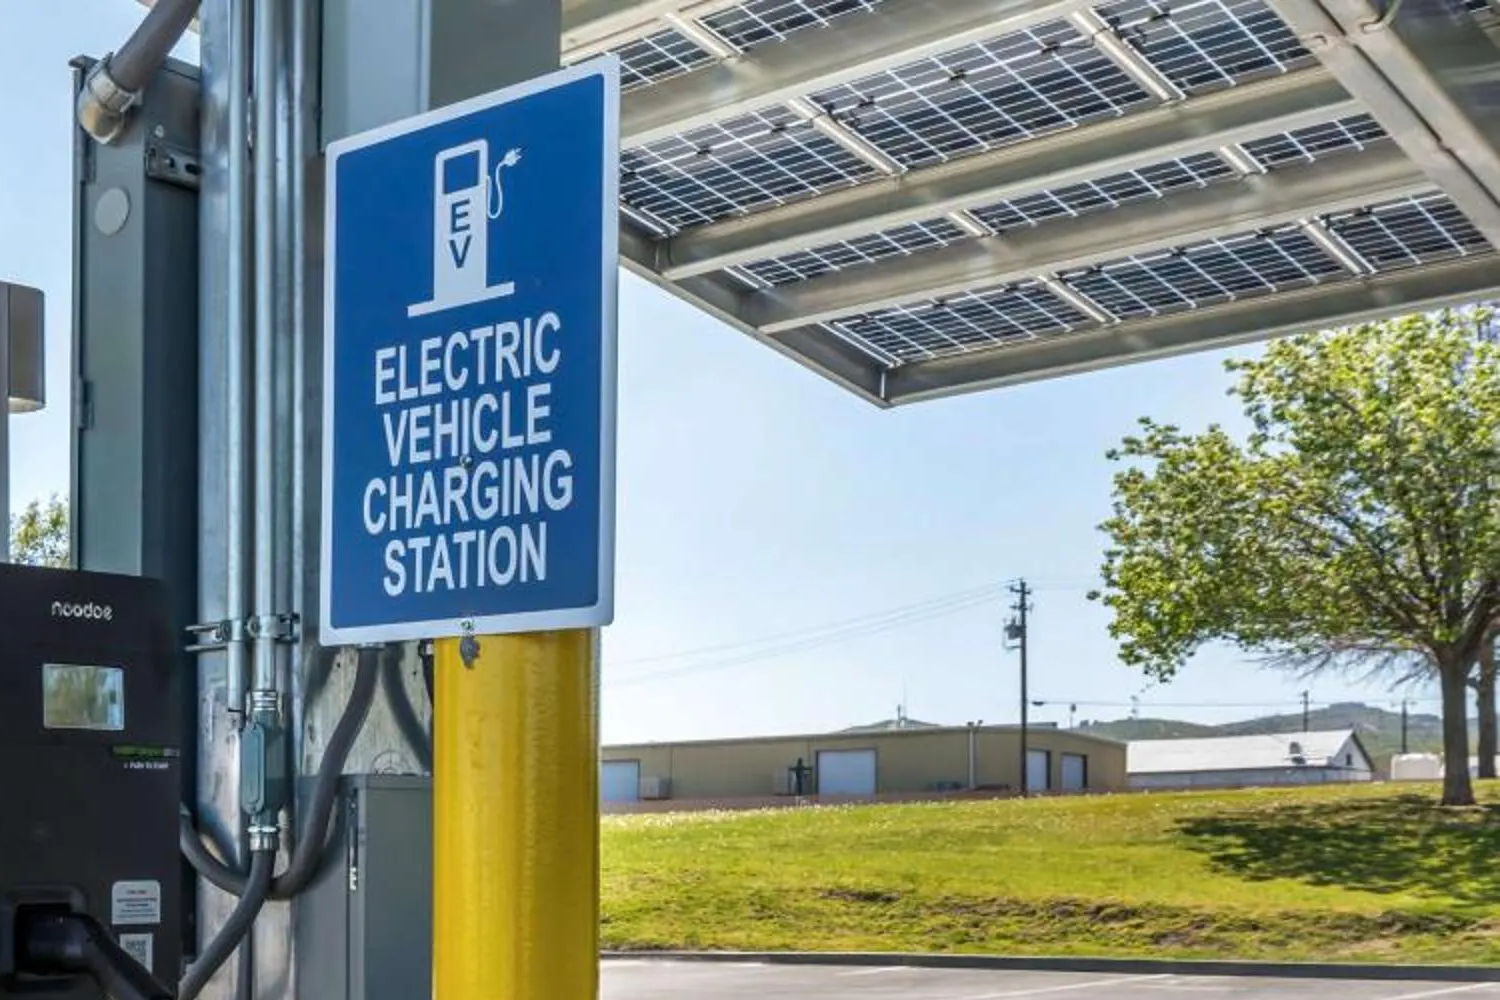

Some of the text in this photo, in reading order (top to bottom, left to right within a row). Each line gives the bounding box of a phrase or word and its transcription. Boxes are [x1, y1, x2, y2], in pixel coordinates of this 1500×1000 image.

[375, 311, 561, 405] ELECTRIC
[383, 383, 551, 467] VEHICLE
[363, 449, 573, 535] CHARGING
[383, 521, 547, 596] STATION
[51, 600, 113, 620] noodoe
